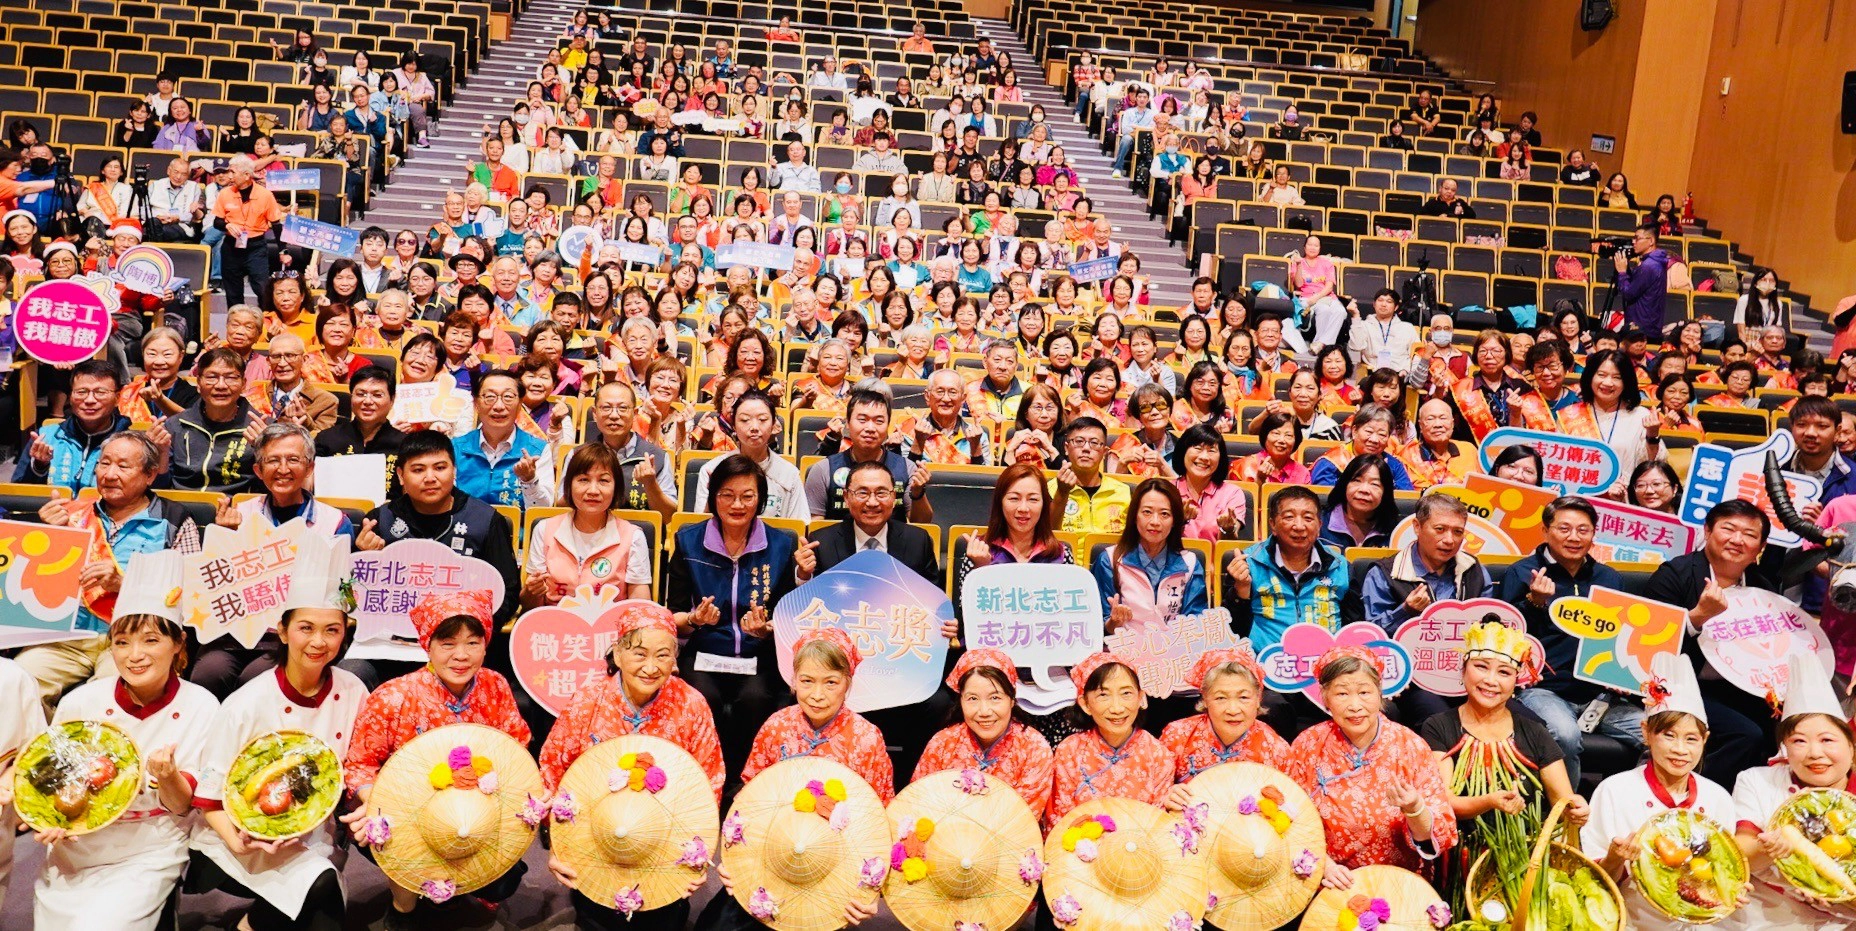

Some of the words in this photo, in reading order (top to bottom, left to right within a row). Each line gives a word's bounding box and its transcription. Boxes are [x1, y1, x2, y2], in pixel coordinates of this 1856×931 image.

[128, 265, 158, 286] 陶博
[28, 297, 101, 325] 我志工
[23, 321, 98, 349] 我驕傲
[1532, 441, 1602, 465] 志力傳承
[1545, 463, 1599, 485] 望傳遞
[1690, 457, 1726, 508] 志工
[1601, 514, 1675, 548] 陣來去
[200, 539, 295, 590] 我志工
[354, 558, 463, 588] 新北志工
[363, 588, 437, 614] 感謝
[976, 586, 1088, 614] 新北志工
[1558, 604, 1592, 626] let's
[1595, 618, 1616, 633] go
[1707, 611, 1805, 640] 志在新北
[530, 631, 618, 663] 微笑服
[977, 620, 1091, 647] 志力不凡
[1104, 609, 1238, 662] 志心奉獻
[1414, 649, 1463, 672] 溫暖
